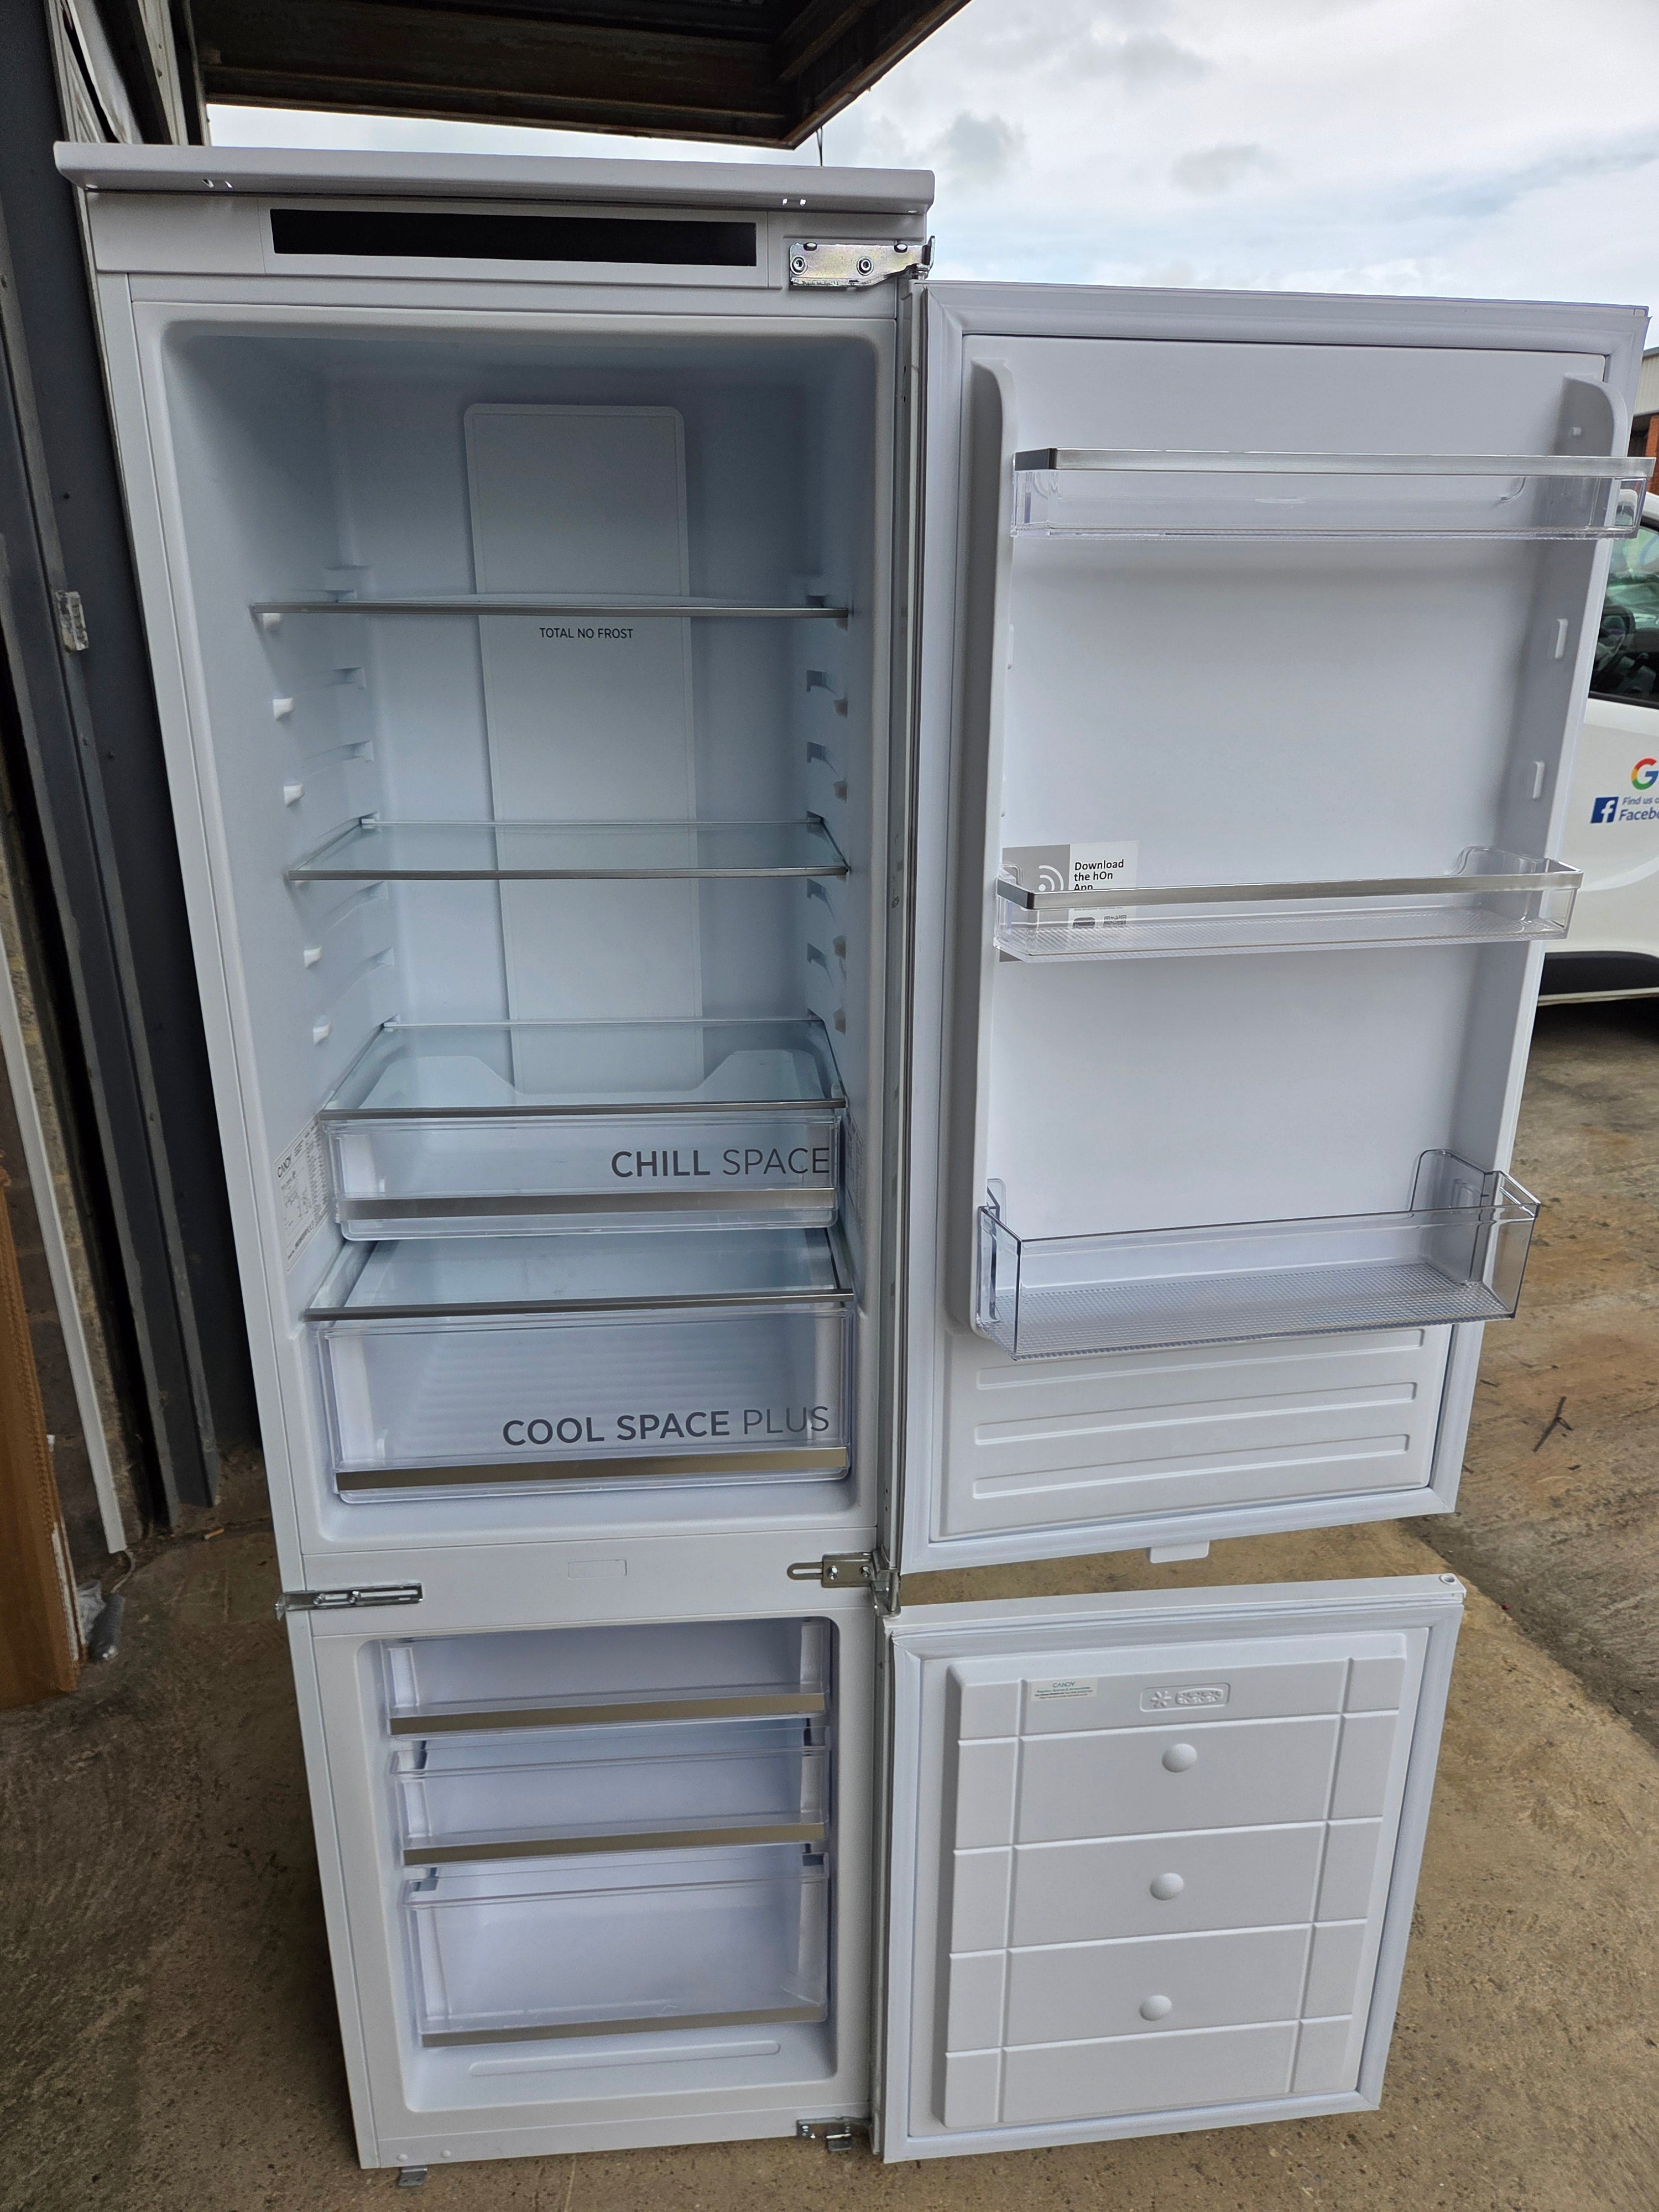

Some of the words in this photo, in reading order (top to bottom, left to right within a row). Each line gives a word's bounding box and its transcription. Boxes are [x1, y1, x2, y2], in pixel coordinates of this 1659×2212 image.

[539, 627, 575, 638] TOTAL
[577, 628, 594, 639] NO
[597, 628, 634, 639] FROST
[1622, 796, 1641, 805] Find
[1074, 859, 1124, 870] Download
[1074, 872, 1091, 881] the
[1093, 871, 1113, 880] hOn
[611, 1150, 711, 1178] CHILL
[722, 1147, 830, 1175] SPACE
[502, 1417, 605, 1446] COOL
[616, 1411, 730, 1441] SPACE
[743, 1406, 830, 1435] PLUS
